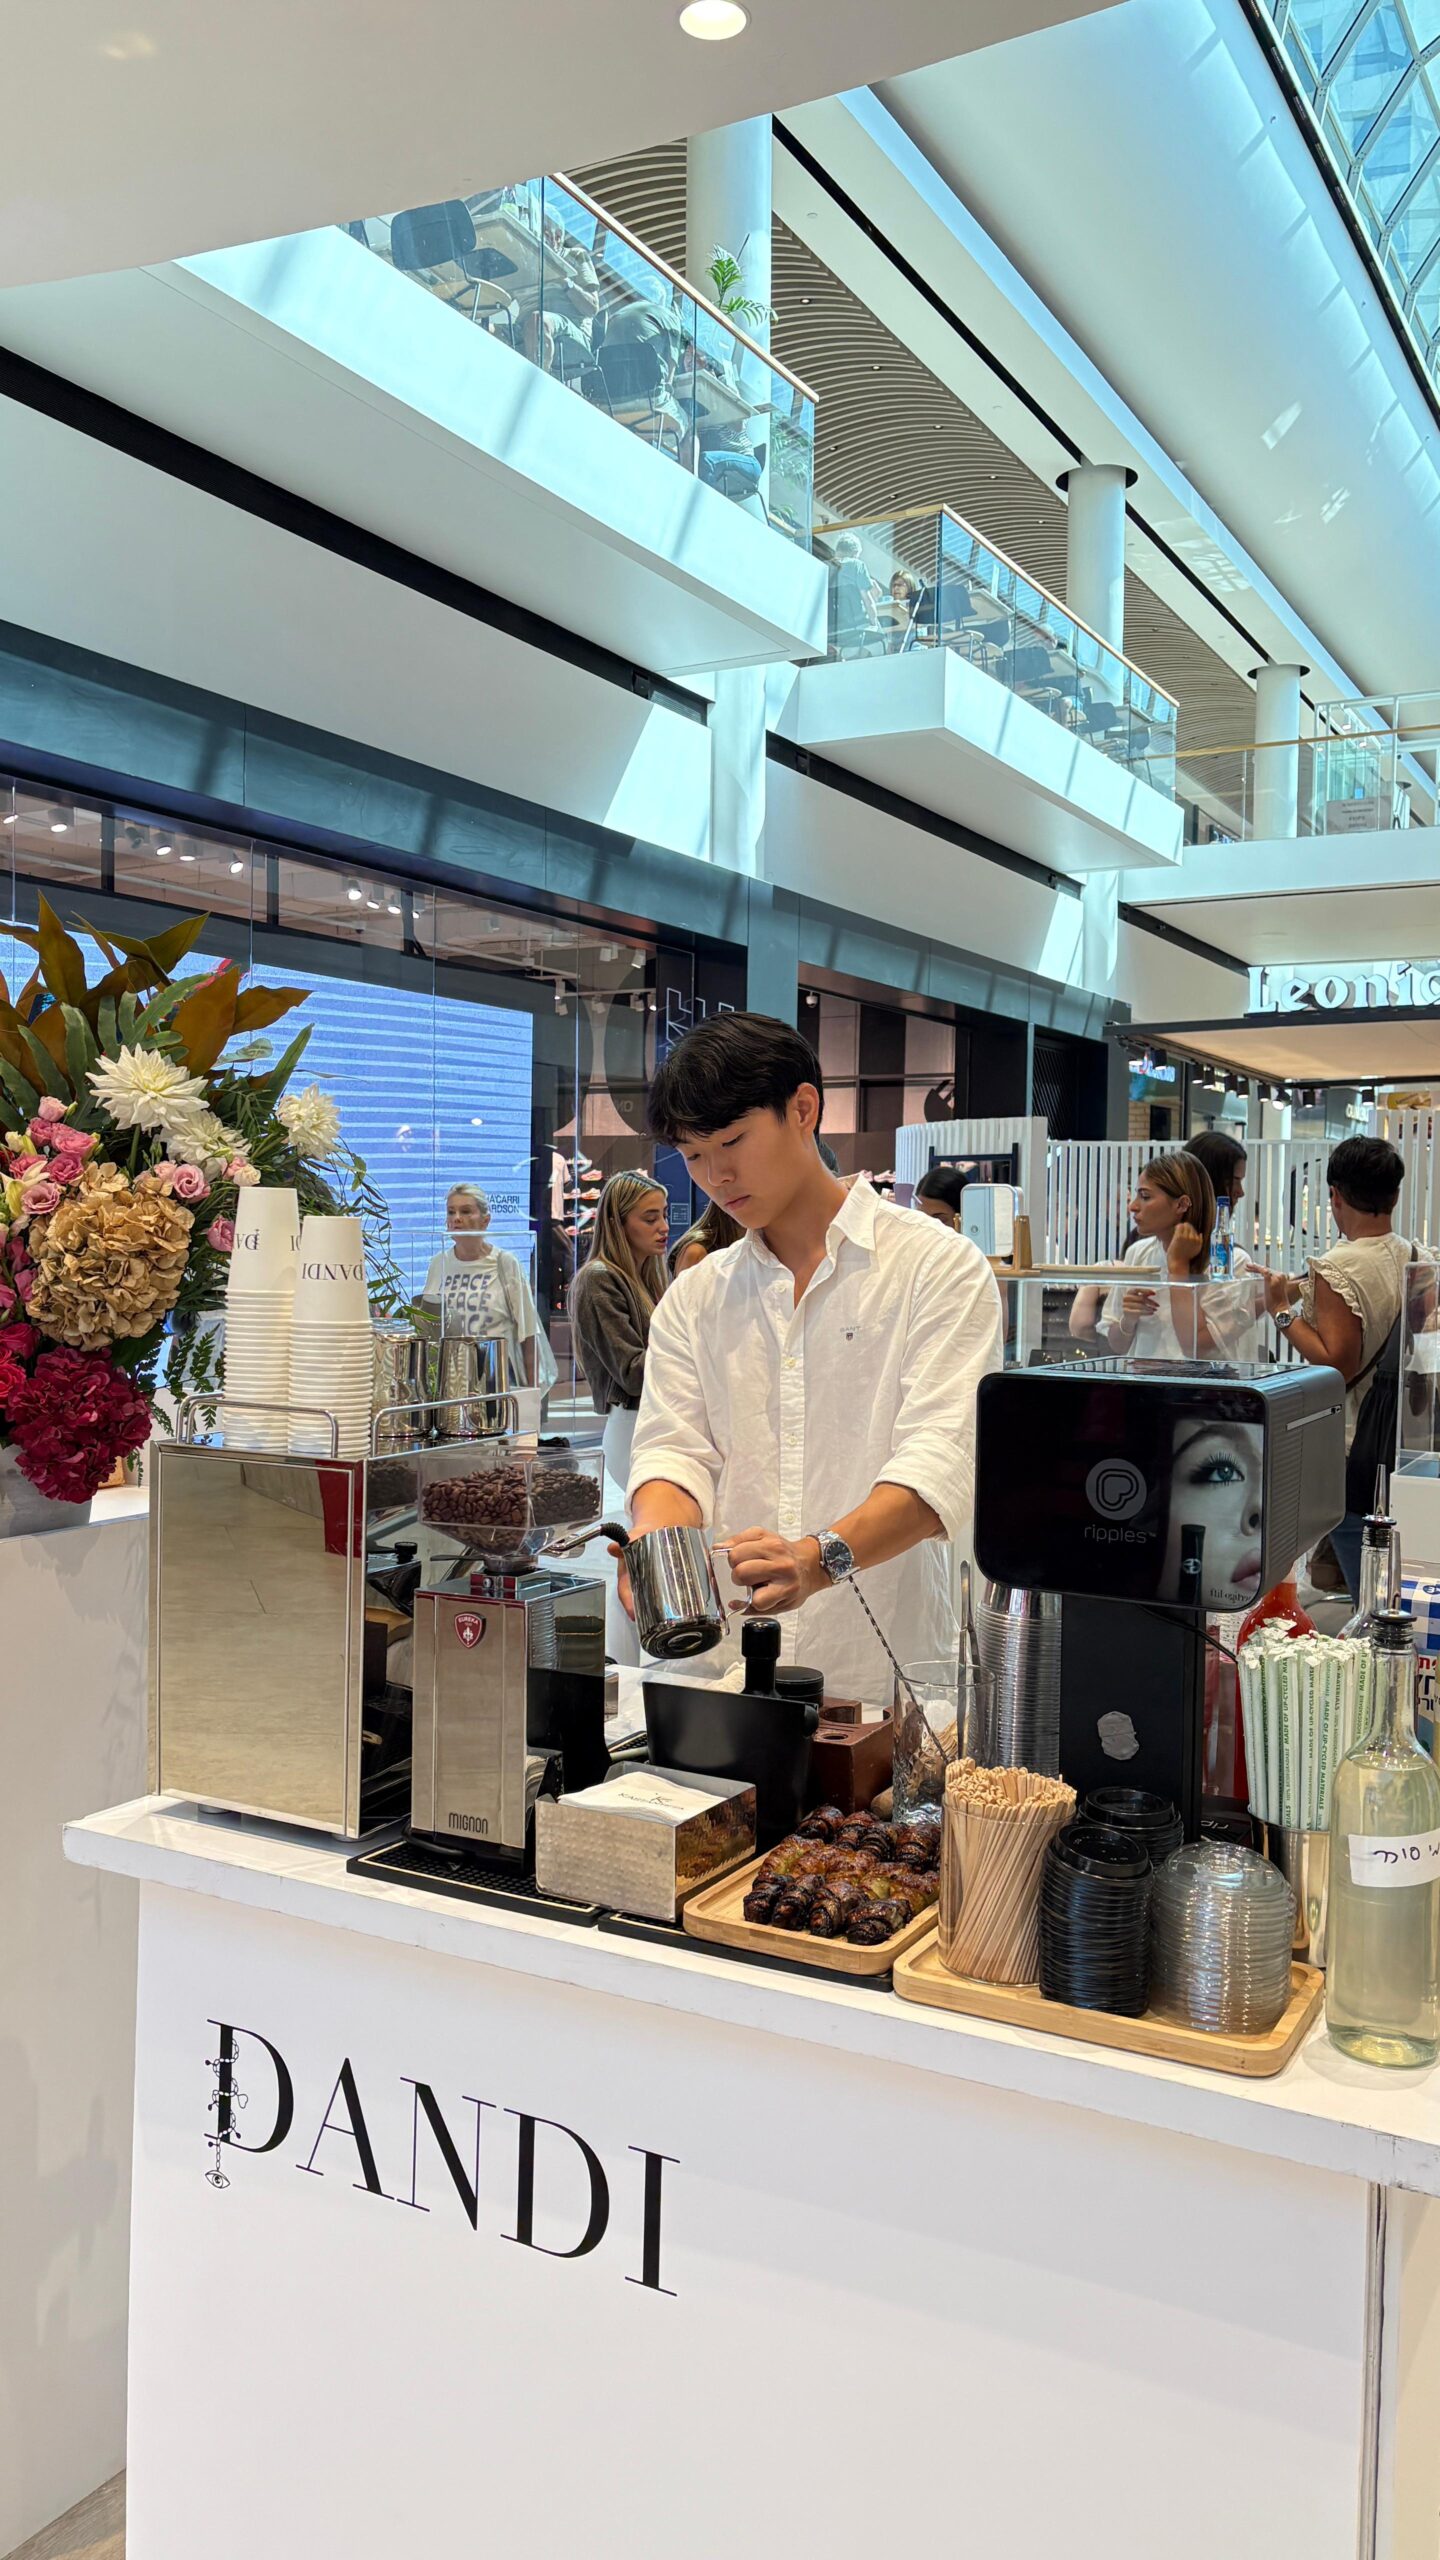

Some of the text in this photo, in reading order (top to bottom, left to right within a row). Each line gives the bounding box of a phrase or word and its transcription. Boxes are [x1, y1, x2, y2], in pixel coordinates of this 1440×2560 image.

[1359, 1671, 1367, 1692] MADE
[1321, 1734, 1329, 1771] UP-CYCLED
[1318, 1773, 1326, 1810] MATERIALS
[203, 2018, 680, 2296] DANDI
